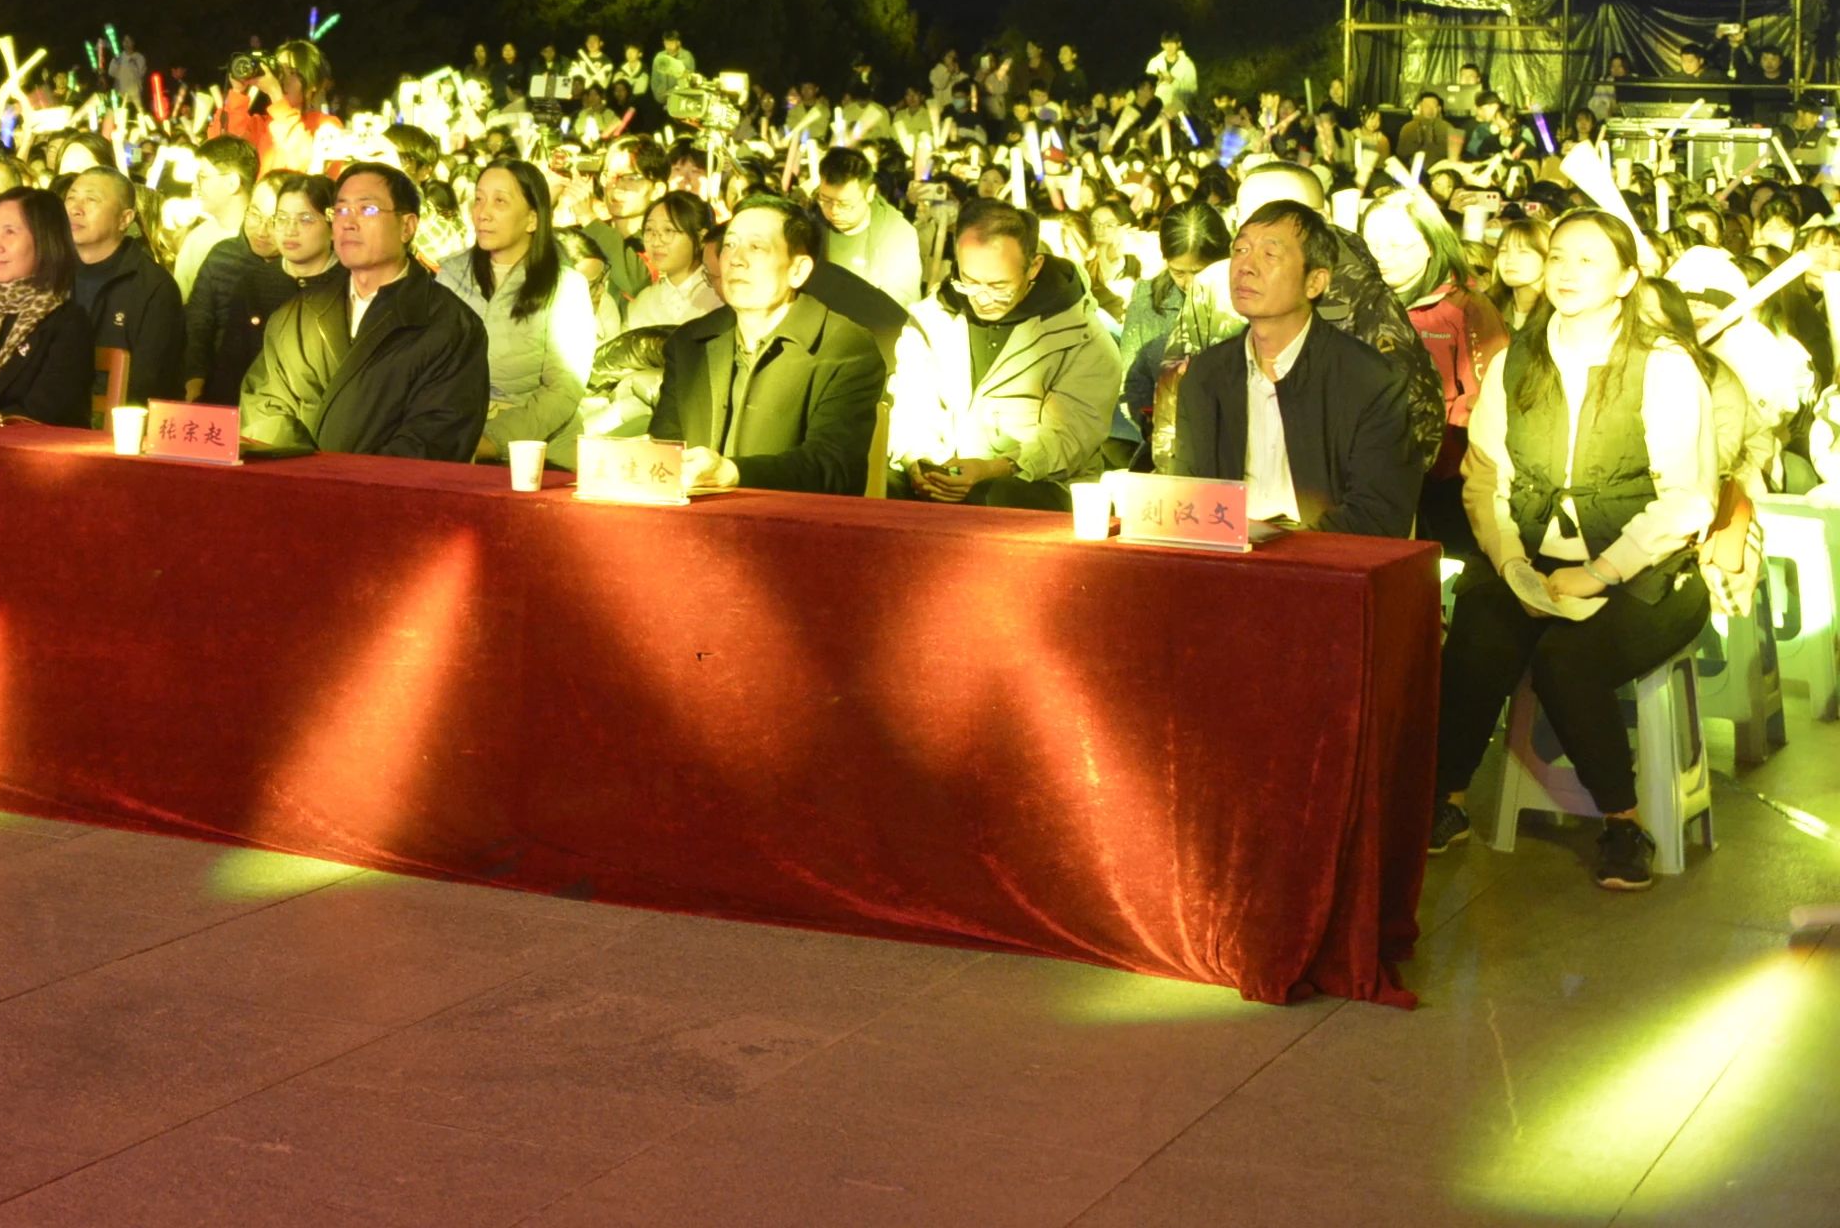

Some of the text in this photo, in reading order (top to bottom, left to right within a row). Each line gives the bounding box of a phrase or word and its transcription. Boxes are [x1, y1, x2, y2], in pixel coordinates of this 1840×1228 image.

[158, 417, 226, 447] 张宗起
[1141, 498, 1236, 531] 刘汉文
